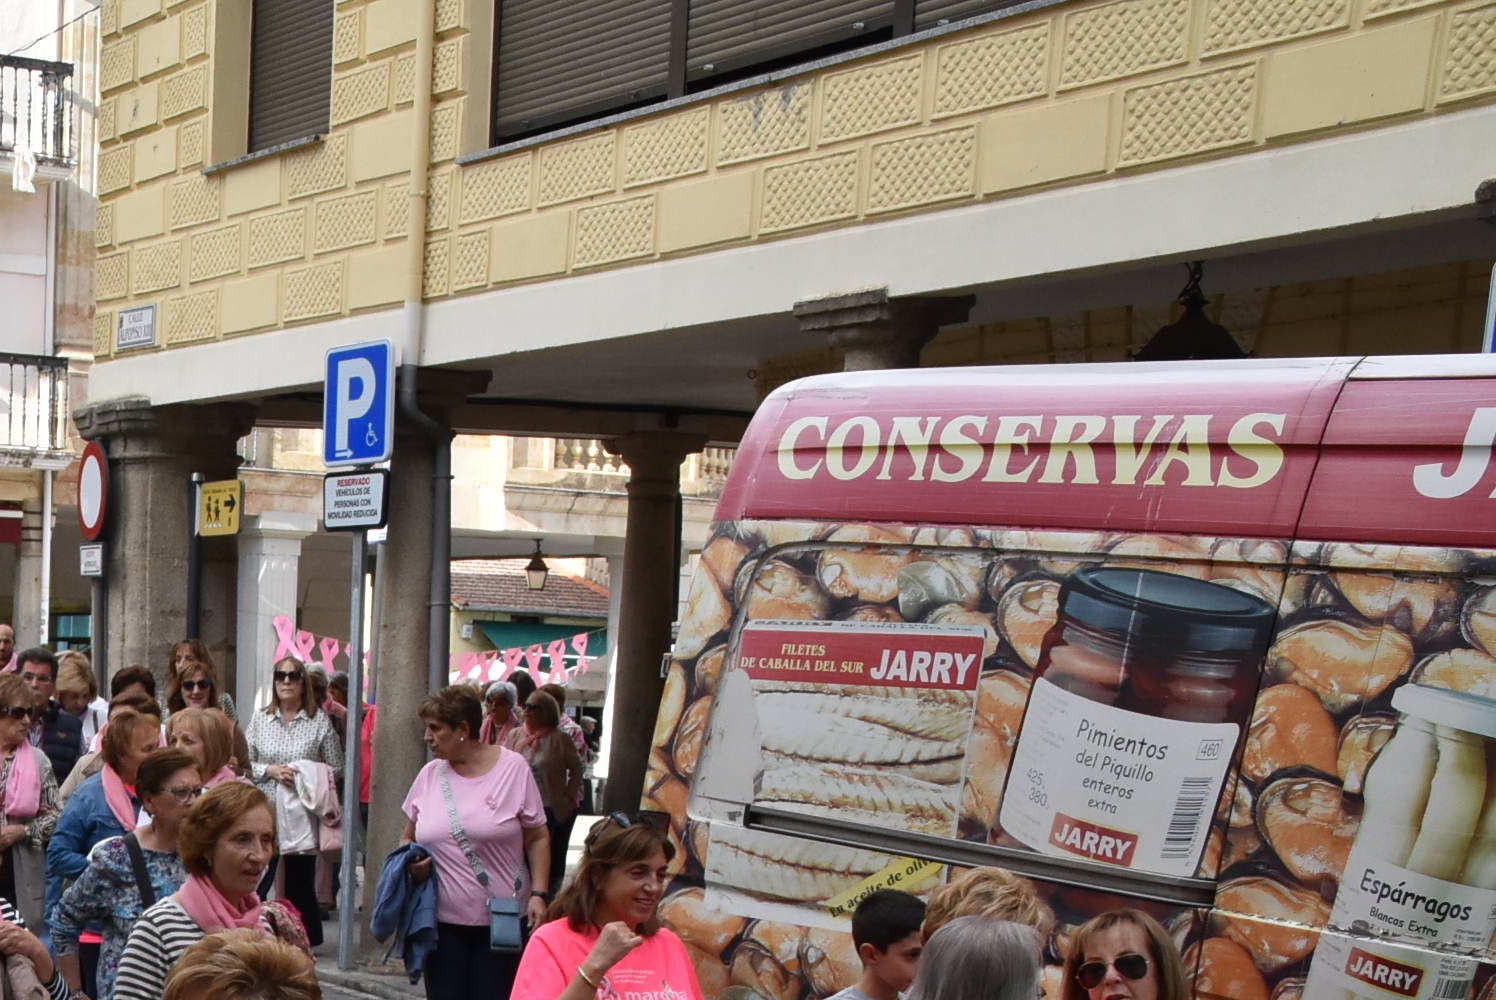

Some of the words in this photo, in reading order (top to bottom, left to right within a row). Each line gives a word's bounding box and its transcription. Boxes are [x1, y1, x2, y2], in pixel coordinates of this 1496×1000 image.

[335, 357, 376, 451] P
[777, 409, 1286, 488] CONSERVAS
[740, 656, 756, 668] DE
[759, 657, 811, 672] CABALLA
[814, 660, 837, 673] DEL
[840, 661, 864, 673] SUR
[781, 644, 826, 657] FILETES
[869, 649, 977, 685] JARRY
[1076, 719, 1168, 760] Pimientos
[1200, 742, 1220, 758] 460
[1075, 750, 1097, 769] del
[1101, 755, 1154, 783] Piquillo
[1082, 776, 1134, 800] enteros
[1087, 797, 1118, 815] extra
[1055, 823, 1132, 861] JARRY
[829, 904, 844, 917] En
[886, 871, 903, 887] de
[906, 858, 934, 876] oliv
[1360, 868, 1472, 924] Espárragos
[1369, 906, 1404, 928] Blancos
[1407, 919, 1438, 938] Extra
[1350, 955, 1418, 990] JARRY
